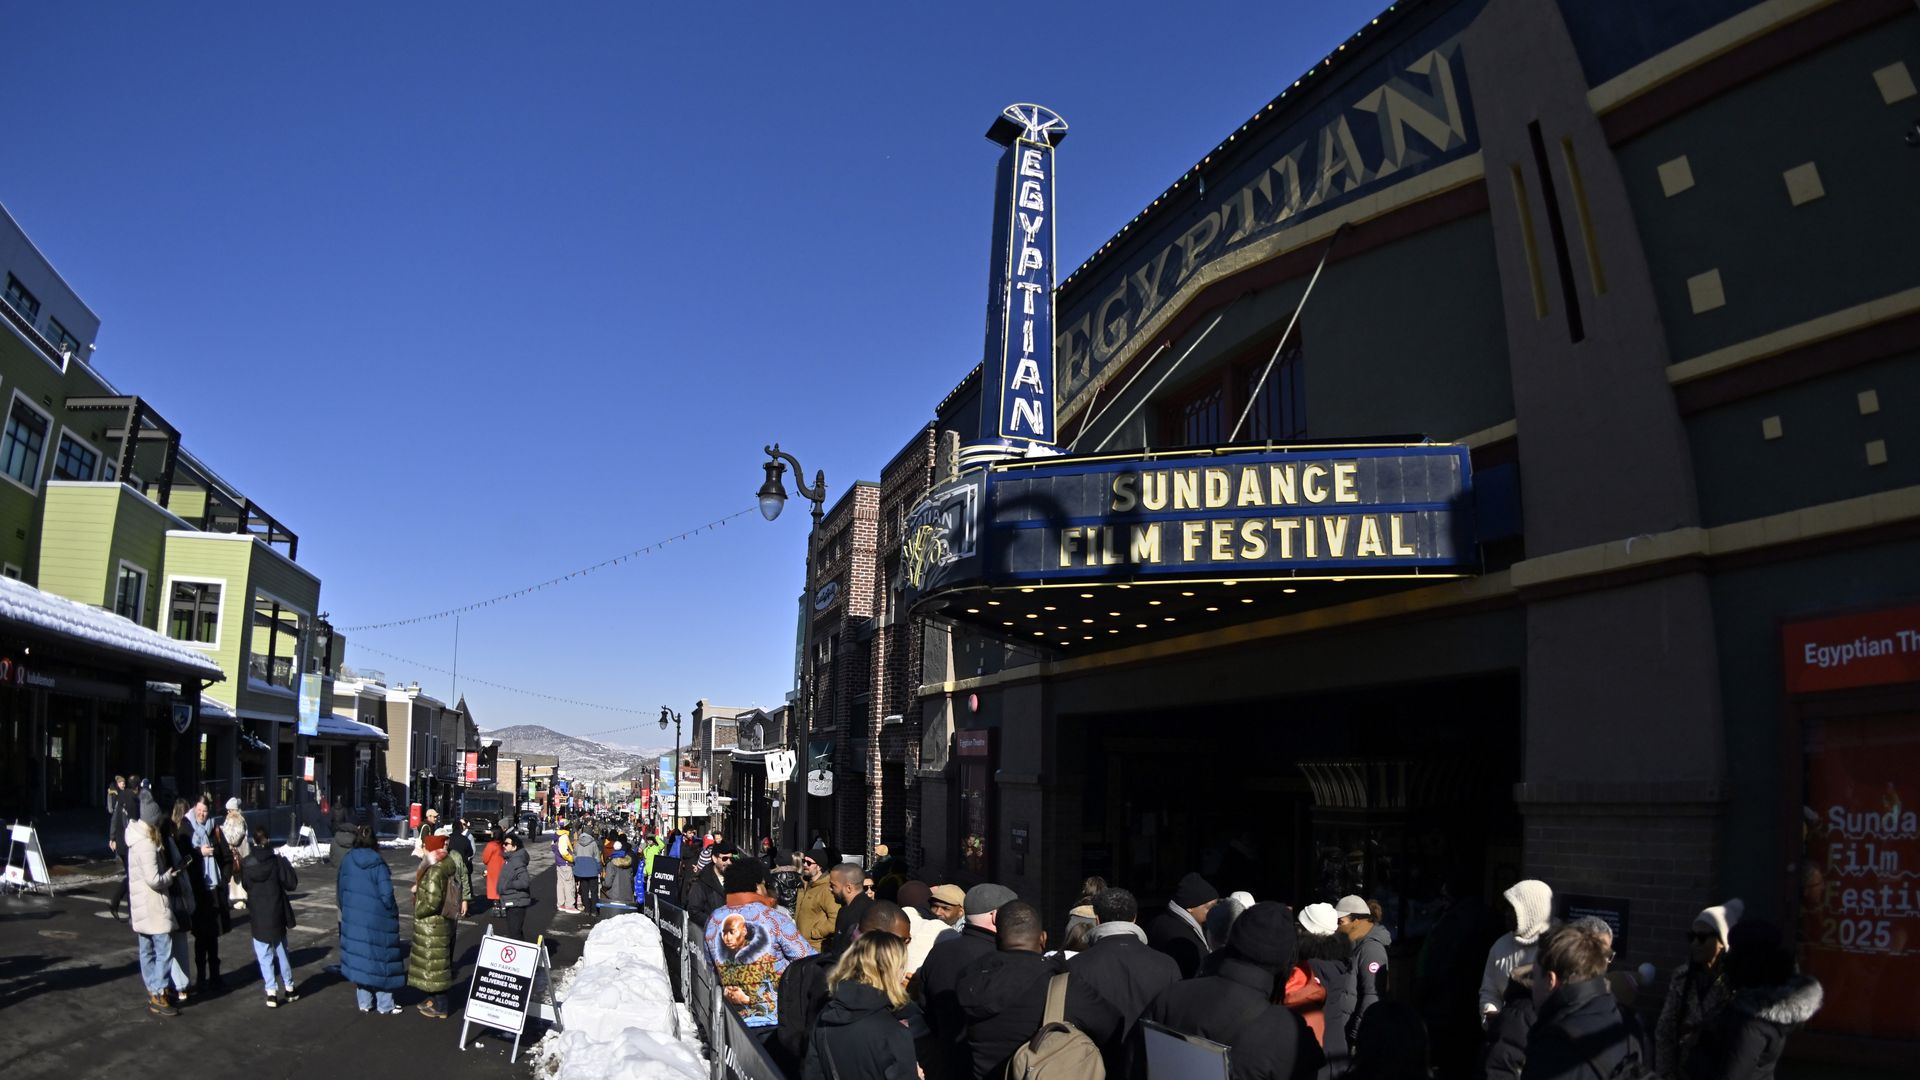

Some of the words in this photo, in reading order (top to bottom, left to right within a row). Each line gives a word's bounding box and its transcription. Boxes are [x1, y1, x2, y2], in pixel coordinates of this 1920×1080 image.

[1057, 43, 1467, 398] EGYPTIAN
[1011, 149, 1045, 436] EGYPTIAN
[1112, 462, 1361, 513] SUNDANCE
[1060, 522, 1162, 568] FILM
[1183, 513, 1417, 562] FESTIVAL
[1803, 635, 1894, 667] Egyptian
[1828, 805, 1918, 833] Sunda
[1827, 843, 1899, 872] Film
[654, 872, 675, 881] CAUTION
[1821, 918, 1892, 947] 2025
[488, 971, 517, 983] PERMITTED
[498, 964, 520, 973] PARKING
[480, 976, 508, 987] DELIVERIES
[508, 983, 523, 991] ONLY
[486, 988, 501, 996] DROP
[475, 992, 488, 1000] PICK
[495, 998, 520, 1008] ALLOWED
